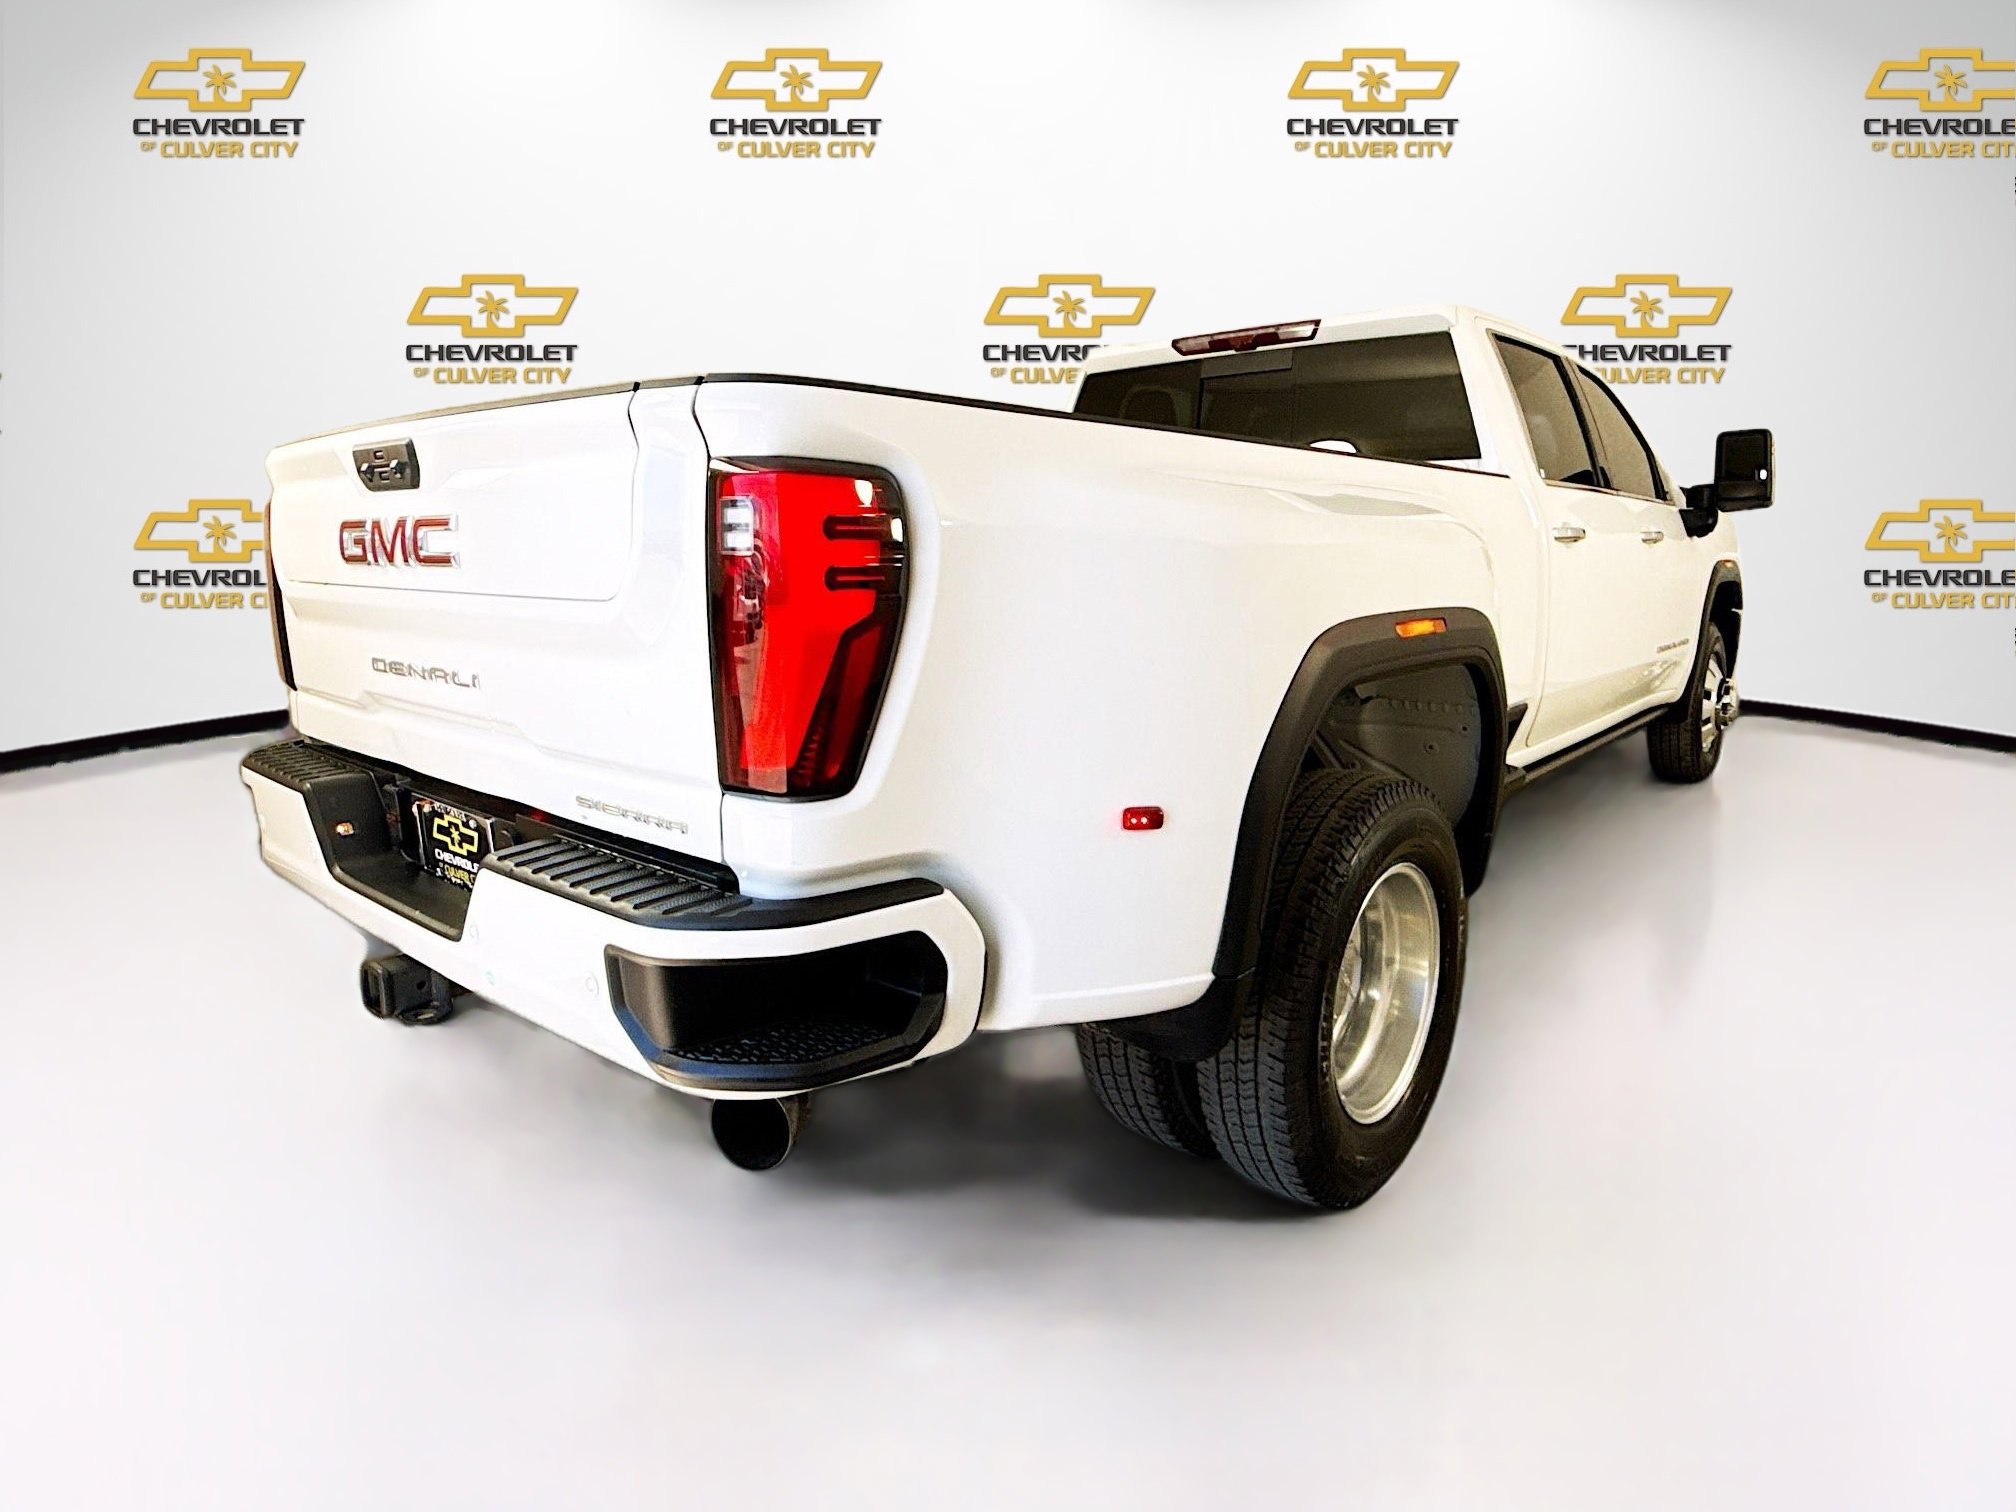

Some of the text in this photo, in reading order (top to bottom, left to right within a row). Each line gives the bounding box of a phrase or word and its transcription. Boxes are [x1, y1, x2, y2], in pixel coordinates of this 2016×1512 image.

[133, 118, 305, 136] CHEVROLET
[710, 118, 882, 136] CHEVROLET
[1287, 118, 1459, 136] CHEVROLET
[1864, 118, 2016, 136] CHEVROLE
[140, 141, 299, 158] OF CULVER CITY
[717, 141, 876, 158] OF CULVER CITY
[1294, 141, 1453, 158] OF CULVER CITY
[1871, 141, 2016, 158] OF CULVER CIT
[406, 344, 578, 362] CHEVROLET
[983, 344, 1102, 361] CHEVR
[1563, 344, 1732, 361] HEVROLET
[413, 367, 572, 384] OF CULVER CITY
[990, 367, 1079, 384] OF CULVE
[1597, 367, 1726, 384] ULVER CITY
[339, 514, 459, 568] GMC
[133, 569, 267, 586] CHEVROL
[1864, 569, 2016, 587] CHEVROLE
[140, 592, 268, 609] OF CULVER CI
[1871, 592, 2016, 609] OF CULVER CIT
[371, 656, 480, 689] DENALI
[576, 795, 688, 834] SIERRA
[435, 848, 480, 874] CHEVROLE
